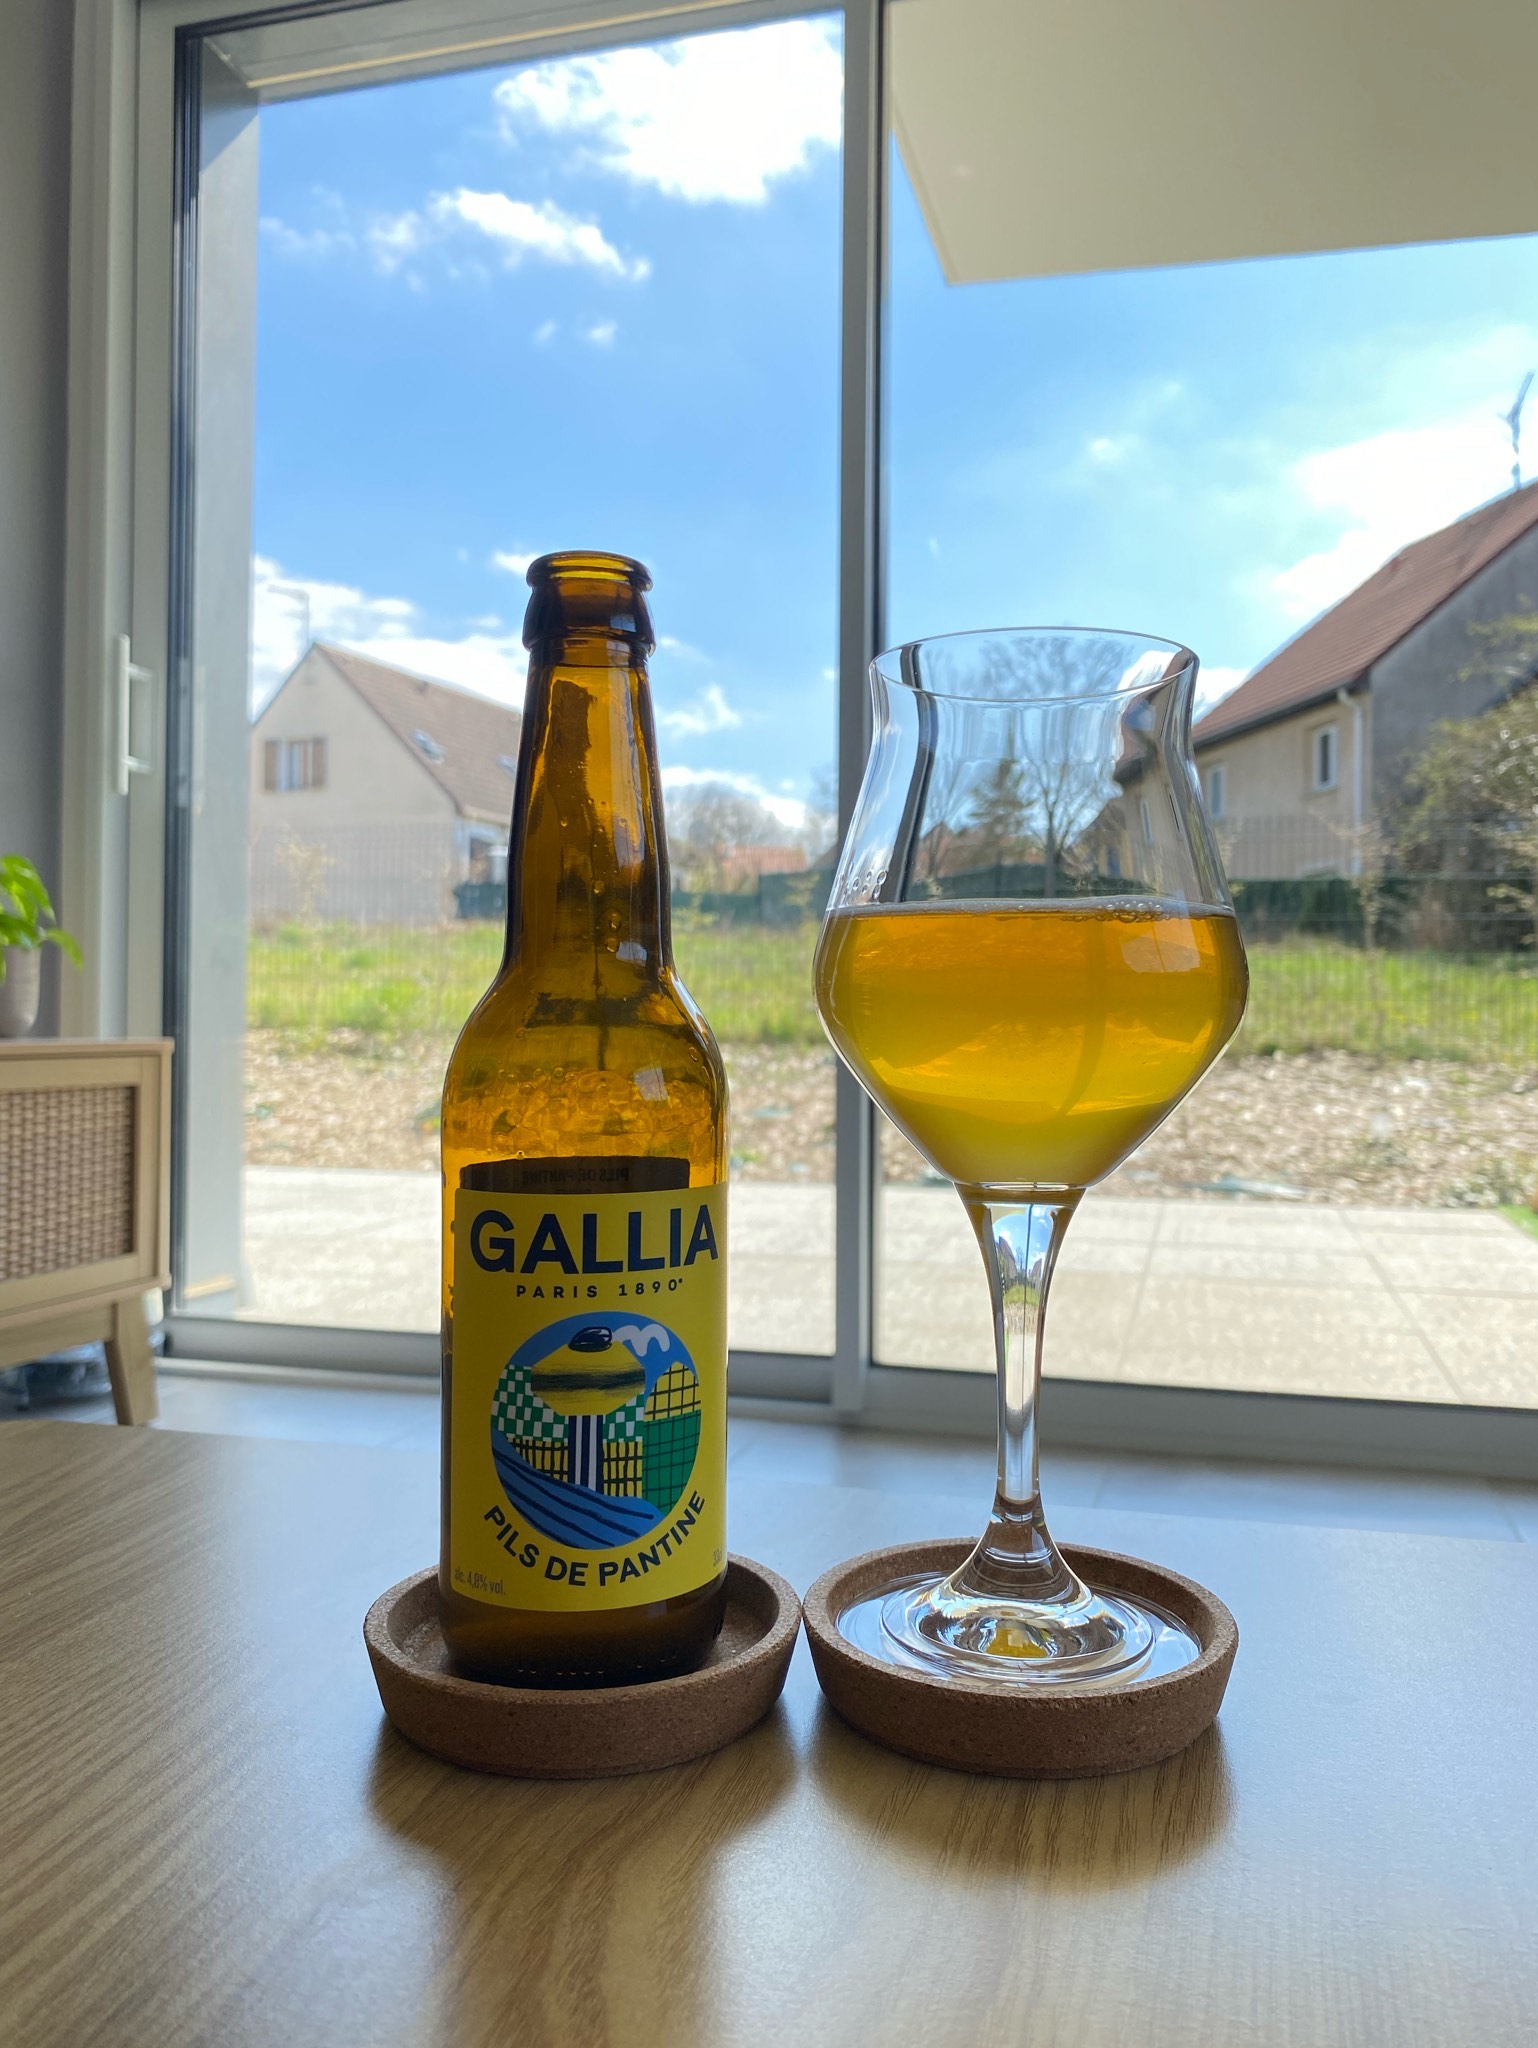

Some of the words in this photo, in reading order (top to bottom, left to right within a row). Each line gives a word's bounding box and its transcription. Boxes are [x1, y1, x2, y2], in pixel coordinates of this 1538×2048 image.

[470, 1204, 719, 1275] GALLIA
[516, 1284, 598, 1298] PARIS
[484, 1505, 540, 1568] PILS
[544, 1555, 589, 1586] DE
[598, 1490, 705, 1587] PANTINE
[467, 1571, 488, 1592] 4,8%
[489, 1579, 506, 1596] vol.
